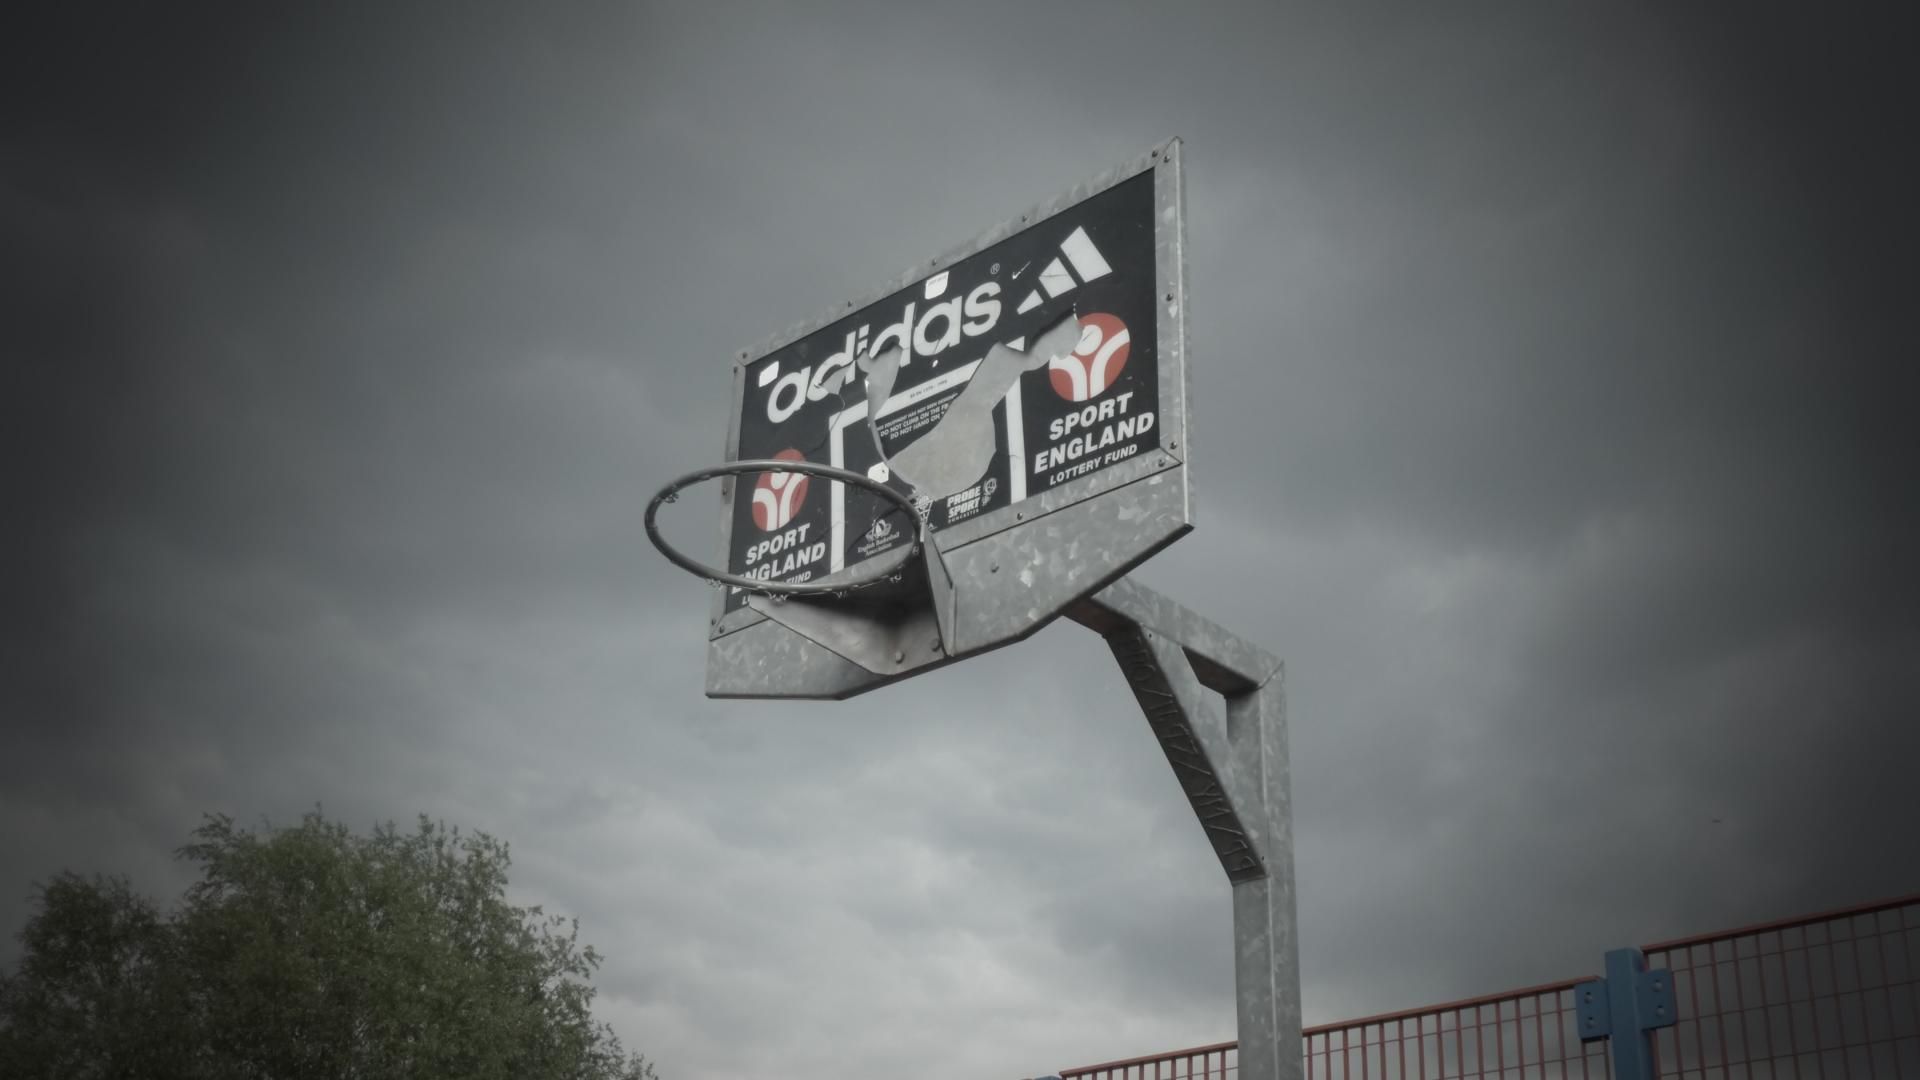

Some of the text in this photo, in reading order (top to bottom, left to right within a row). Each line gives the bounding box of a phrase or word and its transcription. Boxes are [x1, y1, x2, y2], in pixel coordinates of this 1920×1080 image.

[767, 281, 1002, 424] adidas
[880, 429, 889, 438] DO
[890, 423, 902, 434] NOT
[902, 416, 919, 428] CLIMB
[920, 412, 930, 420] ON
[930, 406, 941, 416] THE
[890, 431, 899, 440] DO
[900, 425, 912, 436] NOT
[930, 413, 941, 422] ON
[1049, 391, 1133, 440] SPORT
[1034, 411, 1154, 474] ENGLAND
[1049, 443, 1138, 486] LOTTERY FUND
[946, 485, 981, 508] PROBE
[948, 497, 981, 519] SPORT
[745, 522, 811, 565] SPORT
